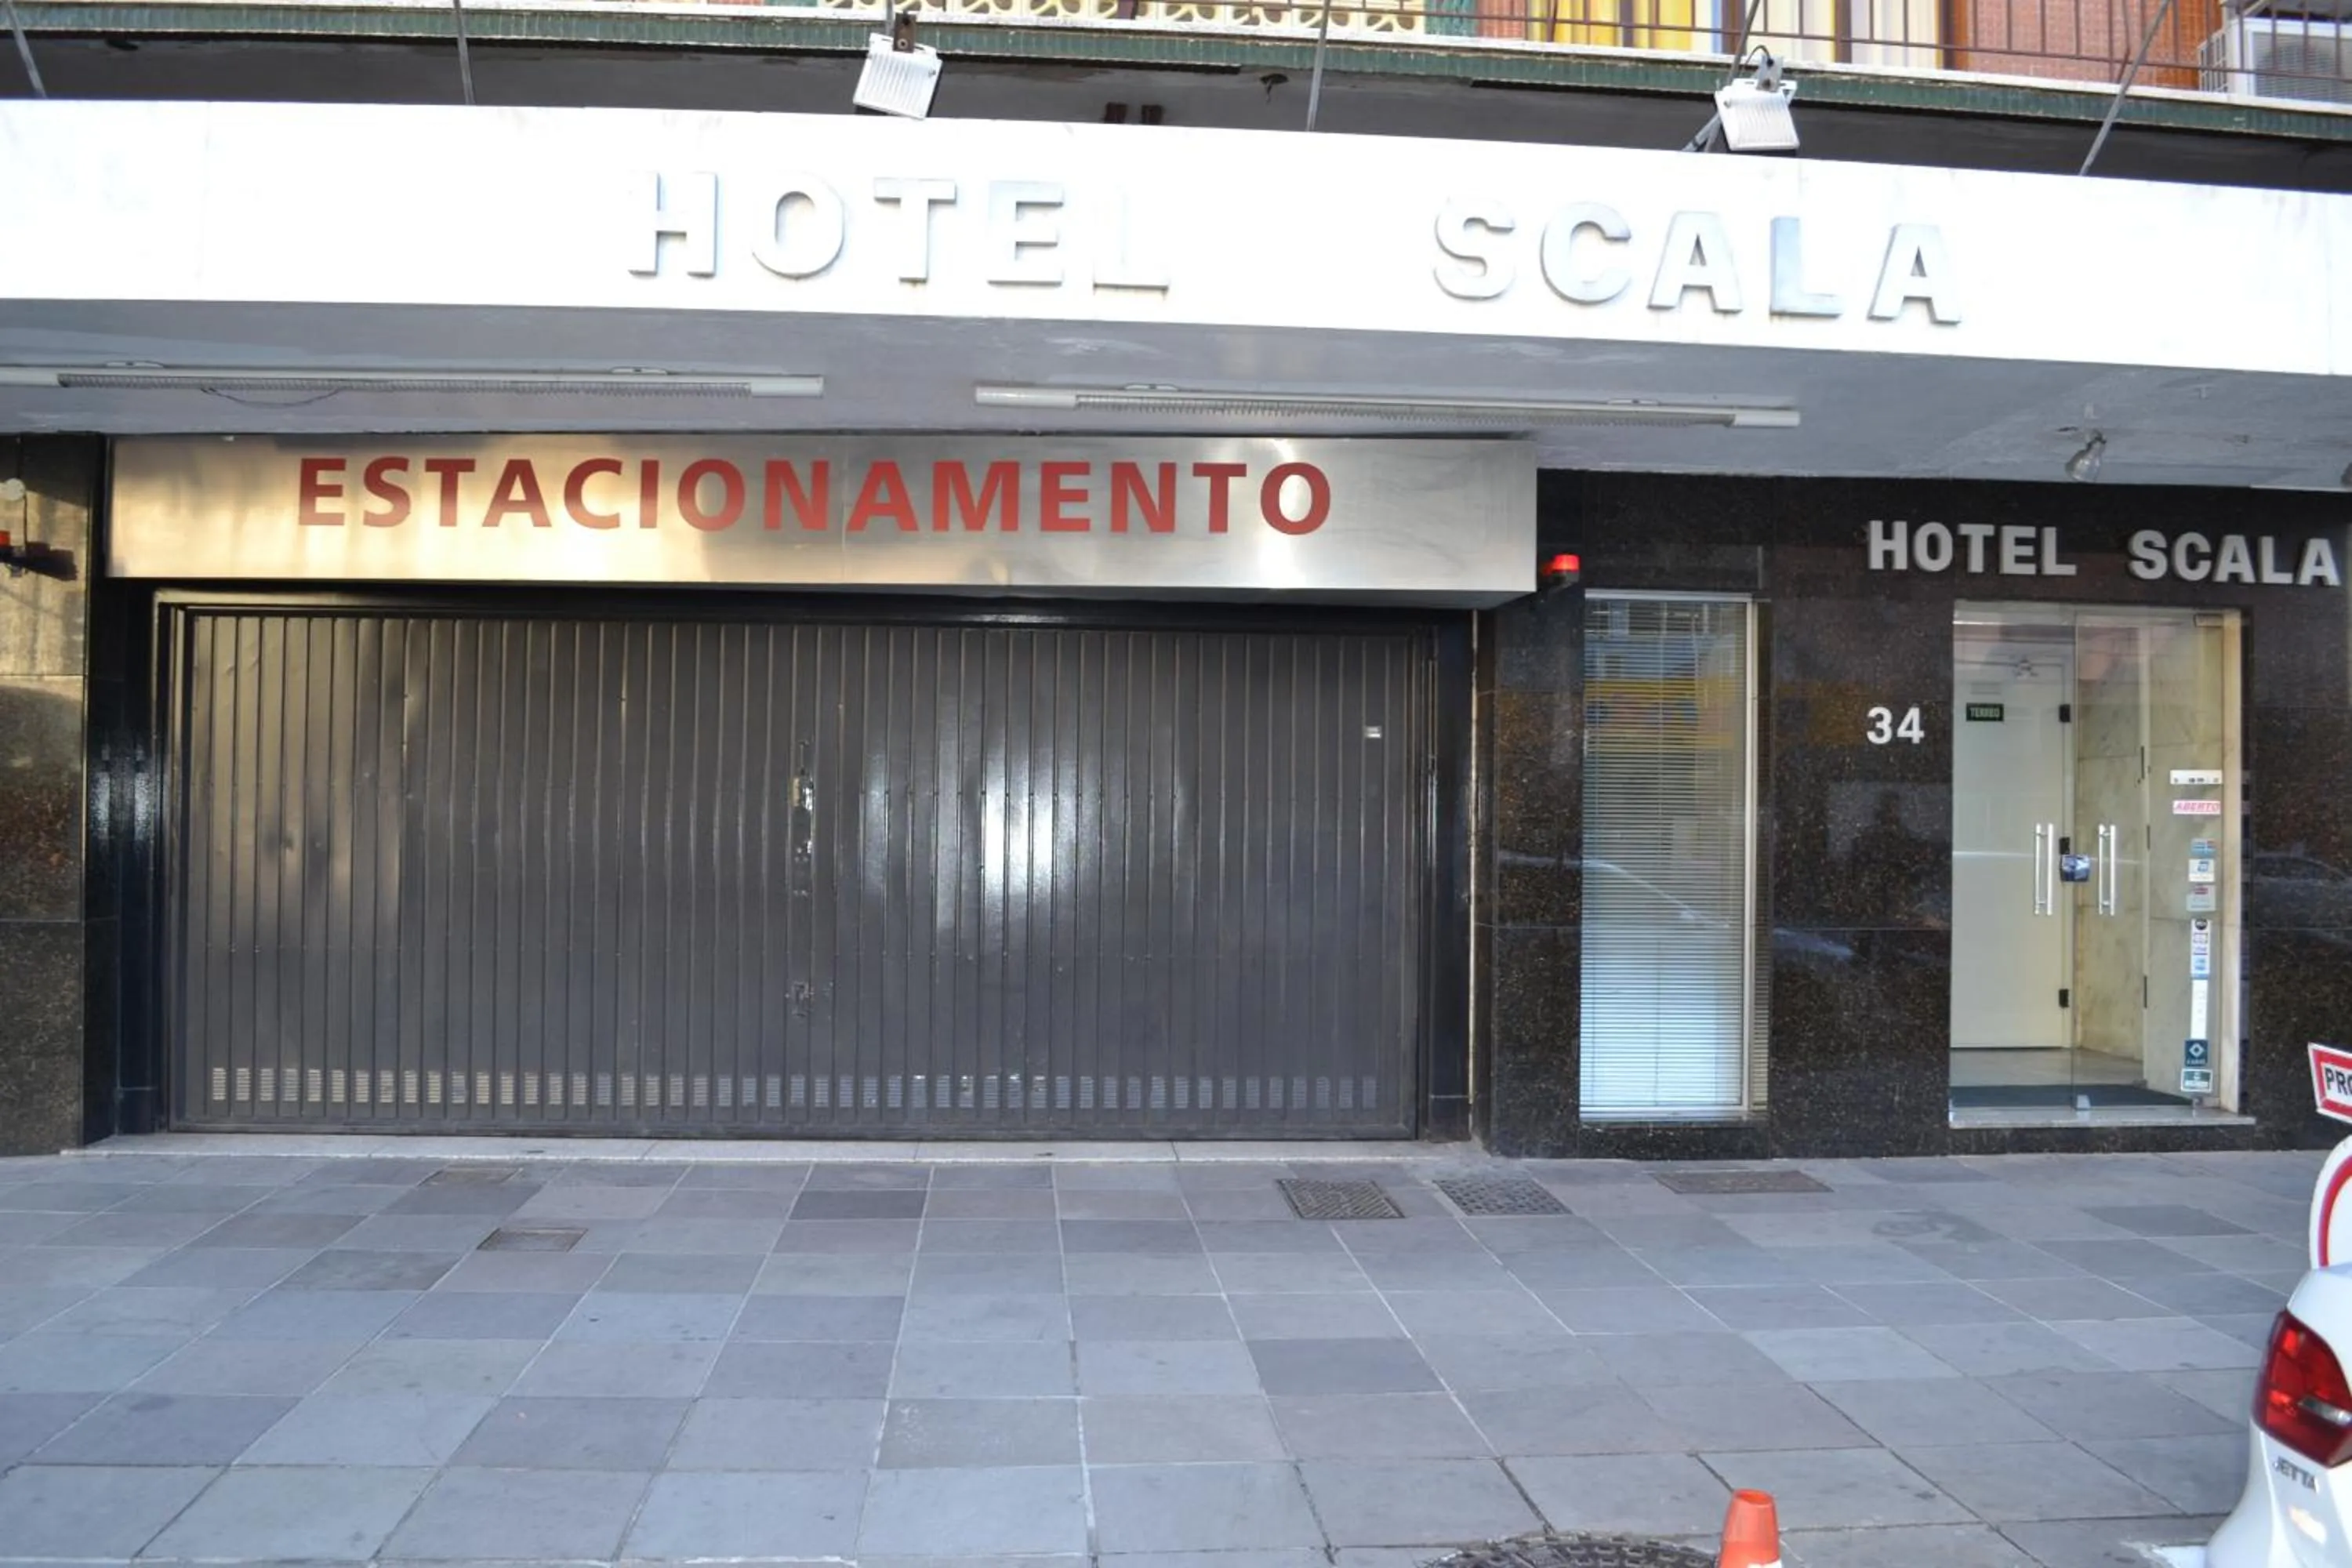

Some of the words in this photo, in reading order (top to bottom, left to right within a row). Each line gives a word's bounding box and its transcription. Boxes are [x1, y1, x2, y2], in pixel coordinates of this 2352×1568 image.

[627, 171, 1171, 292] HOTEL
[1432, 200, 1962, 326] SCALA
[299, 456, 1331, 535] ESTACIONAMENTO
[1867, 520, 2077, 575] HOTEL
[2128, 530, 2341, 586] SCALA
[1867, 706, 1925, 744] 34
[2273, 1456, 2318, 1493] JETTA
